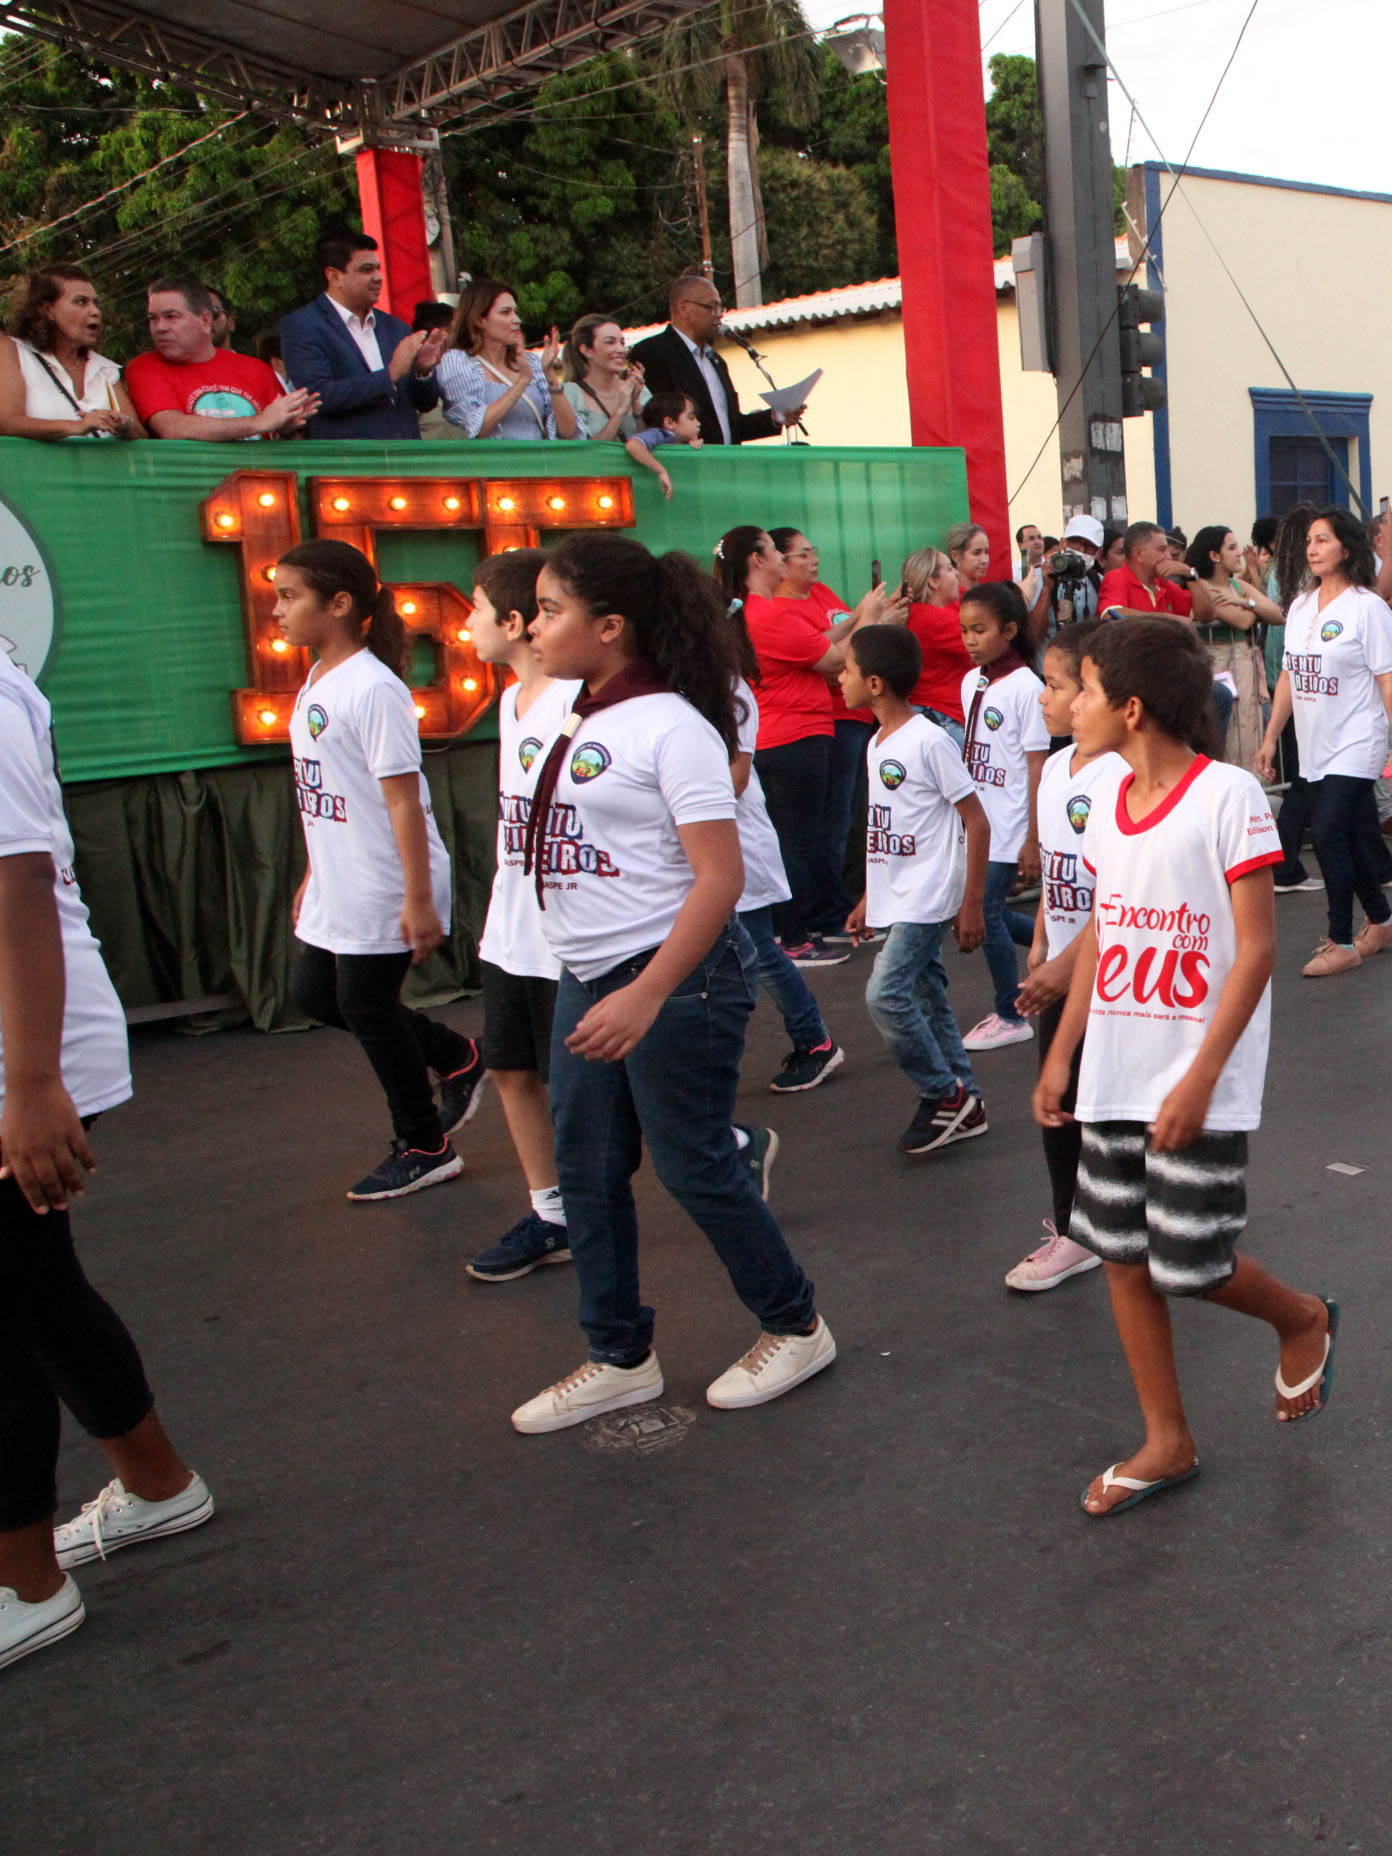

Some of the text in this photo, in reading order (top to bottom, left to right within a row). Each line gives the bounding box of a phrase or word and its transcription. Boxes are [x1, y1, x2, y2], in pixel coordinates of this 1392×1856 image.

[203, 469, 636, 745] 15
[566, 882, 577, 890] JR
[1100, 894, 1210, 935] Encontro
[1172, 934, 1208, 951] com
[1097, 942, 1210, 1008] eus
[1133, 1010, 1151, 1018] mais
